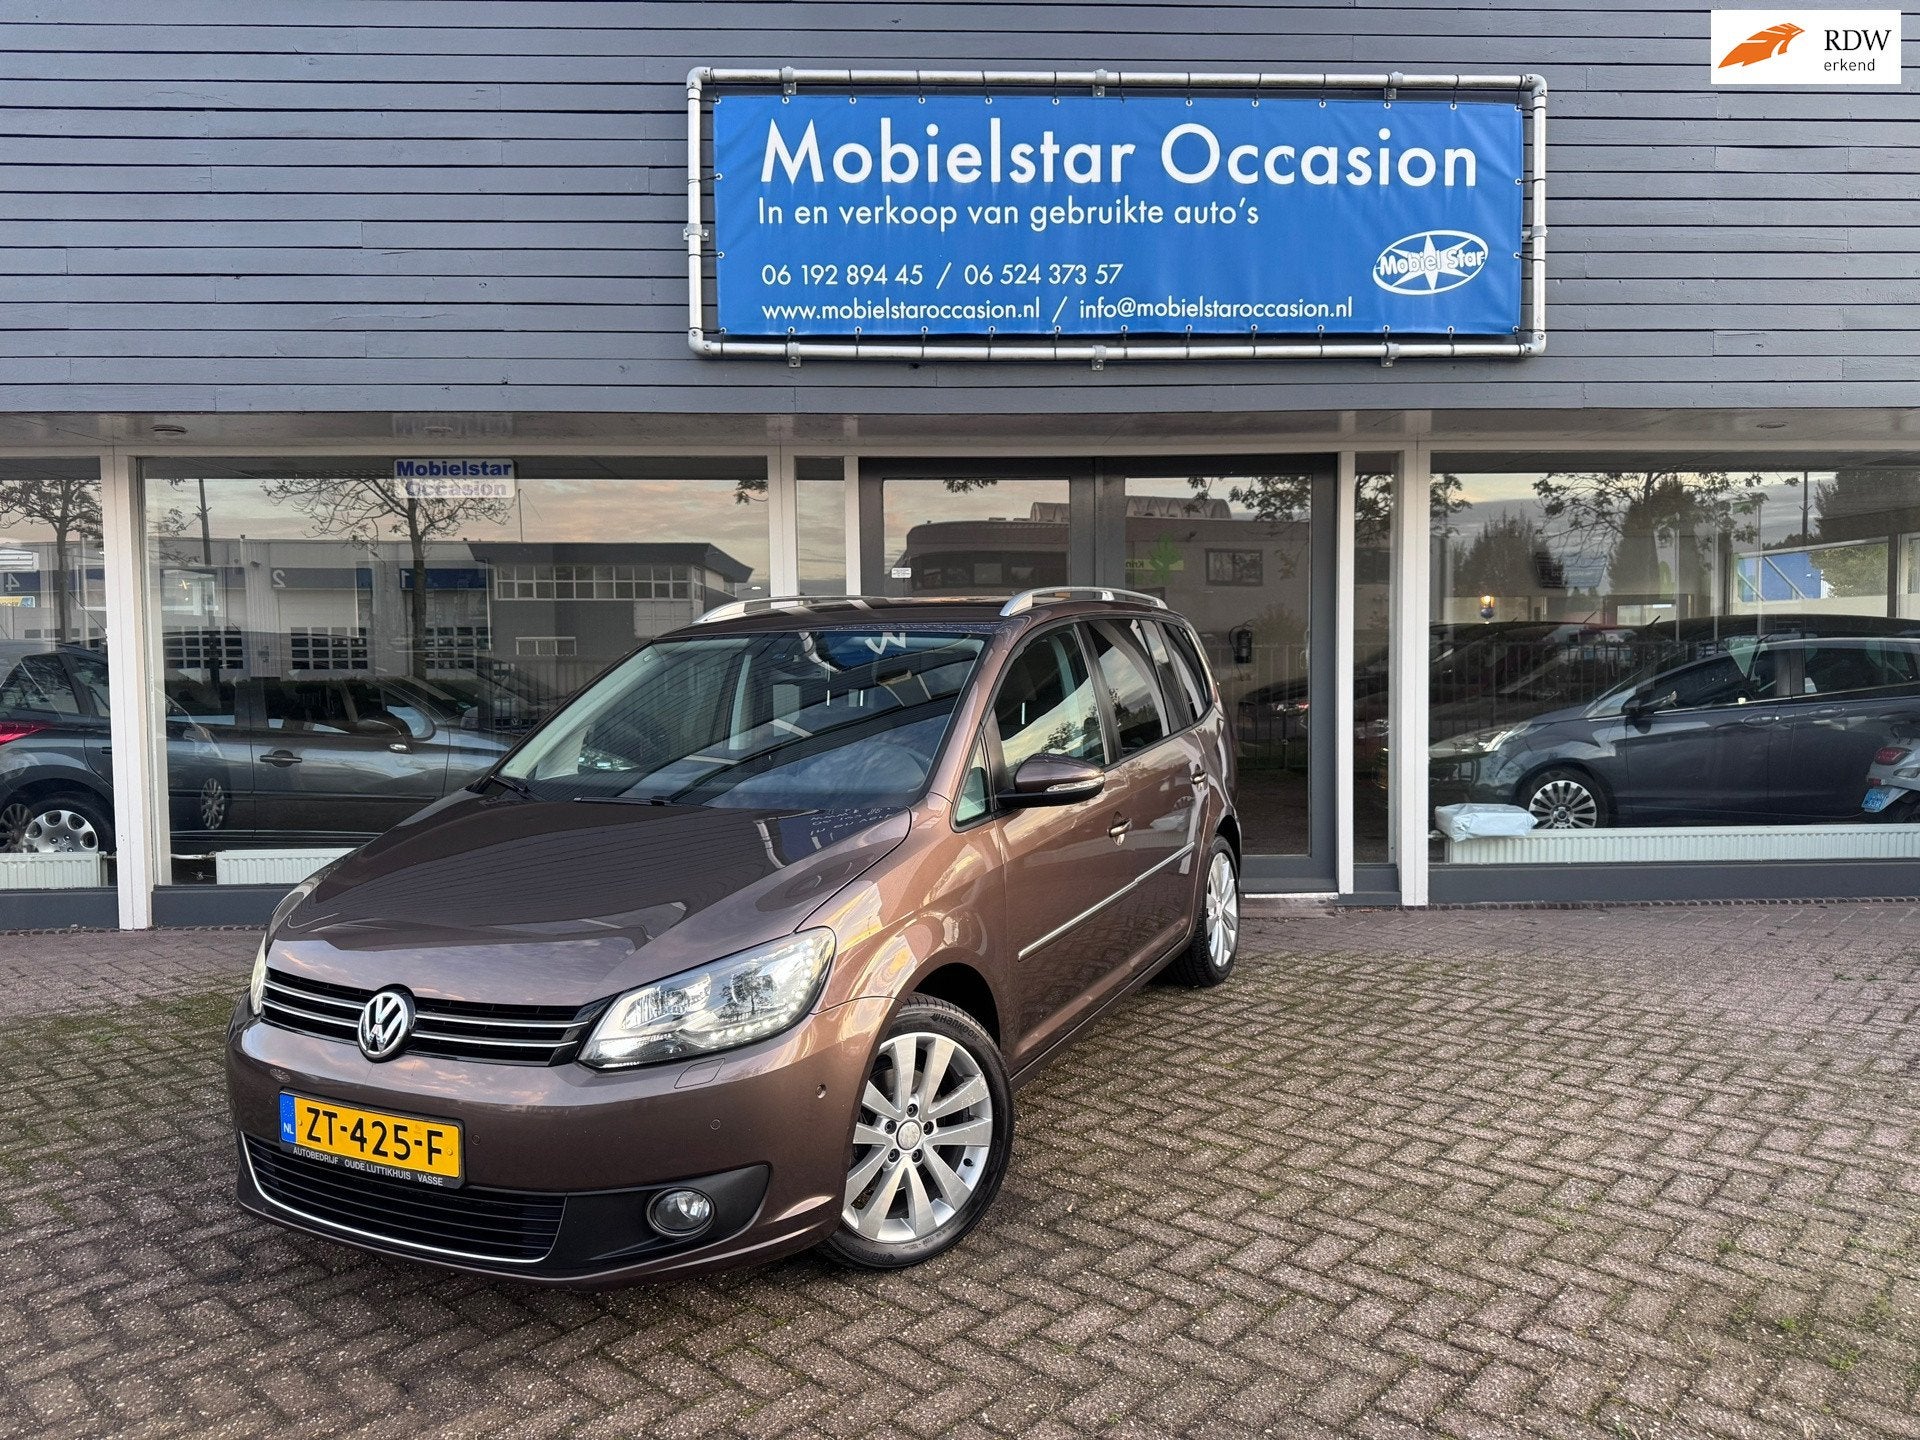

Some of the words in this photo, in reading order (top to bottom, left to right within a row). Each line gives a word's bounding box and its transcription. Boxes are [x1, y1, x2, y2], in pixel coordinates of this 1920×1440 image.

[760, 117, 1136, 185] Mobielstar
[1161, 123, 1477, 187] Occasion
[759, 197, 783, 225] In
[794, 206, 828, 225] en
[838, 194, 957, 233] verkoop
[967, 206, 1019, 225] van
[1030, 194, 1164, 232] gebruikte
[761, 264, 792, 286] 06
[801, 264, 838, 286] 192
[846, 264, 888, 286] 894
[894, 264, 923, 286] 45
[964, 264, 994, 286] 06
[1000, 263, 1042, 285] 524
[1048, 263, 1087, 285] 373
[1094, 263, 1124, 285] 57
[1379, 250, 1442, 276] Mobiel
[1447, 249, 1485, 270] Star
[761, 297, 1040, 320] www.mobielstaroccasion.nl
[1079, 295, 1353, 319] info@mobielstaroccasion.nl
[396, 460, 512, 477] Mobielstar
[405, 479, 507, 497] Occasion
[283, 1122, 295, 1135] NL
[306, 1106, 444, 1166] ZT-425-F
[293, 1146, 339, 1165] AUTOBEDRIJF
[344, 1158, 366, 1172] OUDE
[366, 1163, 412, 1181] LUTTIKHUIS
[417, 1173, 444, 1187] VASSE
